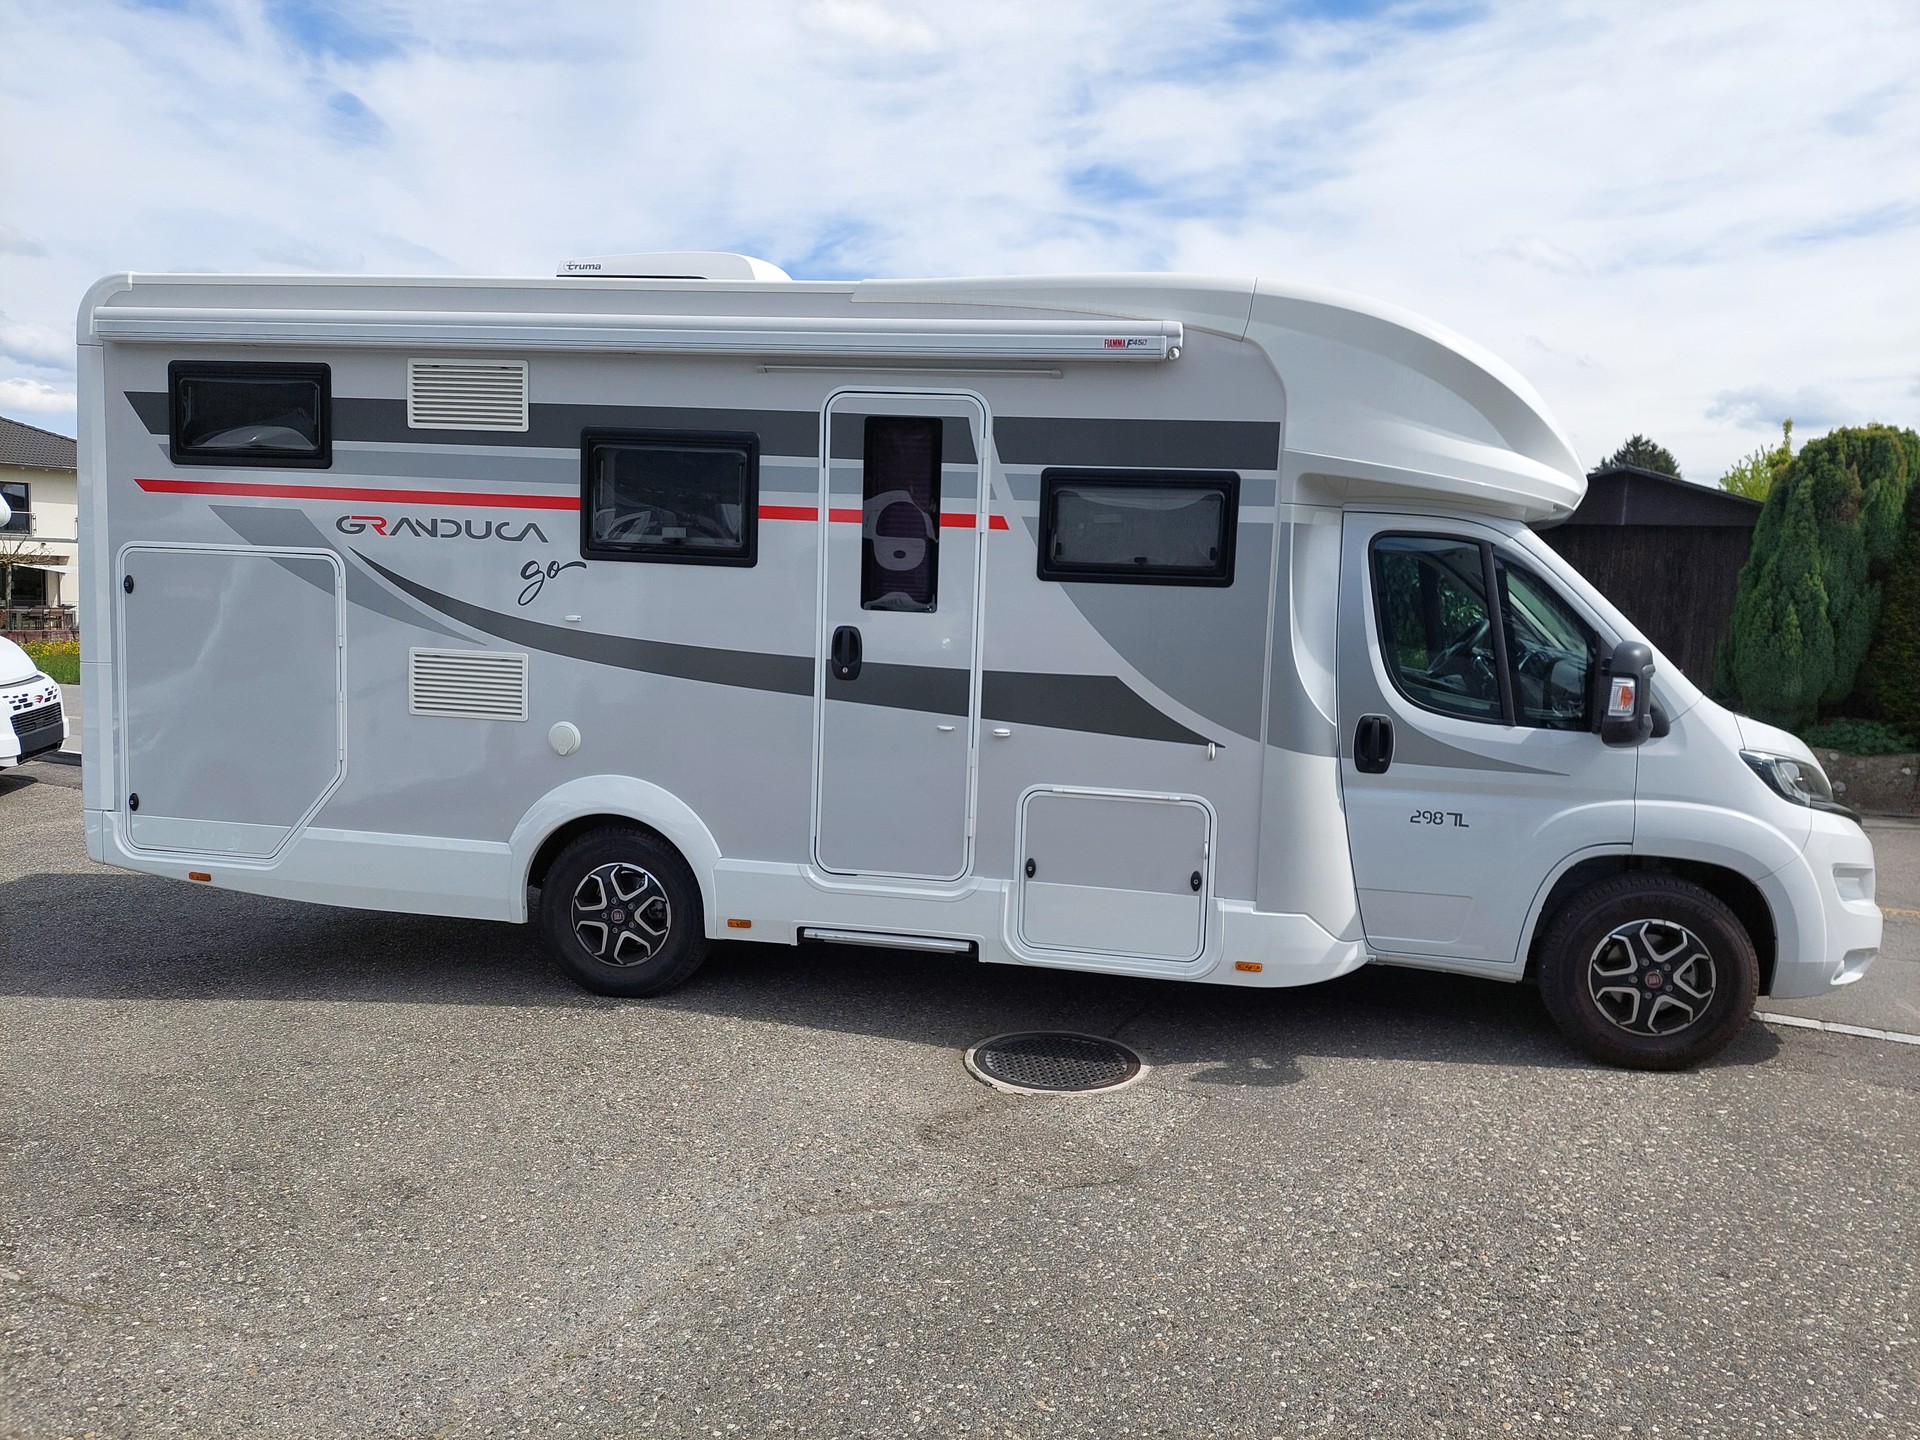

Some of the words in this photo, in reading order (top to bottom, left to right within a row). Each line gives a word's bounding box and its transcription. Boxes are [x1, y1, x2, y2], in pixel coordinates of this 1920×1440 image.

[565, 261, 602, 271] truma
[1104, 338, 1126, 348] FIAMMA
[335, 515, 549, 543] GRANDUCA
[518, 560, 587, 606] go
[1410, 810, 1444, 825] 298
[1446, 812, 1469, 828] TL
